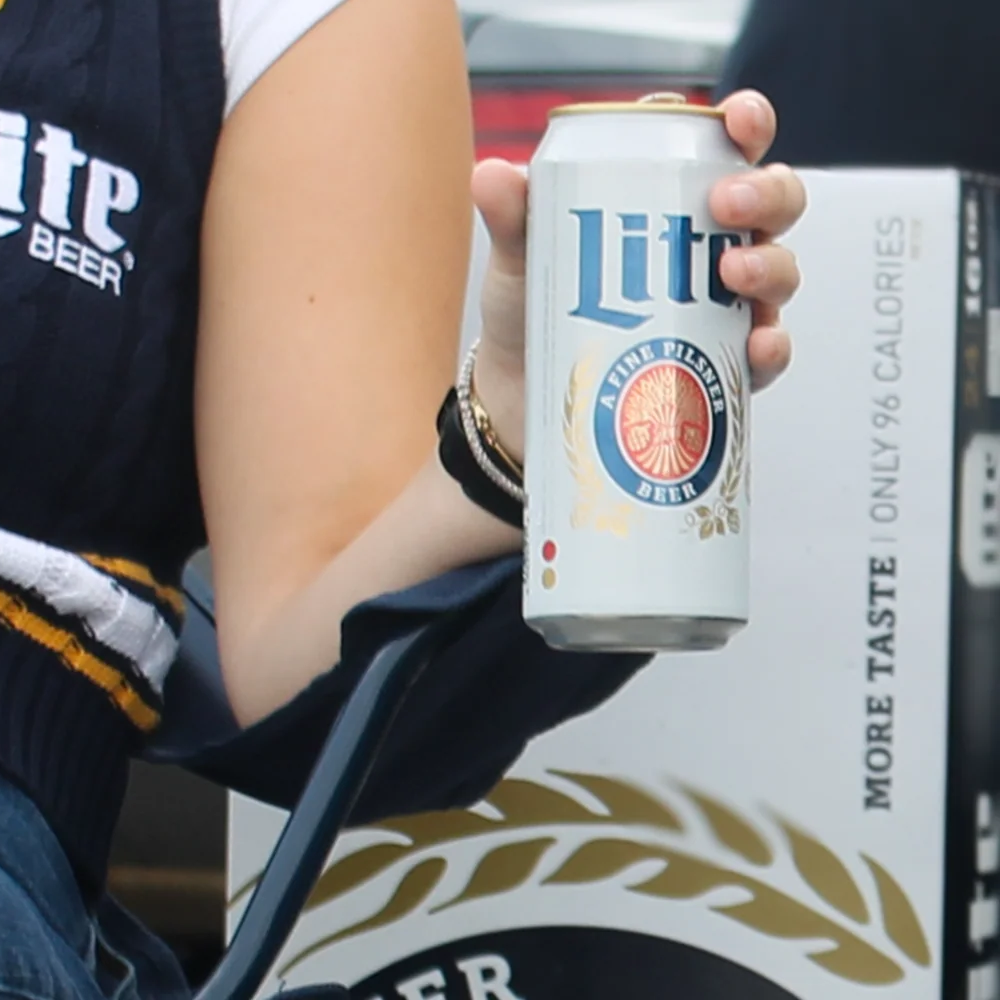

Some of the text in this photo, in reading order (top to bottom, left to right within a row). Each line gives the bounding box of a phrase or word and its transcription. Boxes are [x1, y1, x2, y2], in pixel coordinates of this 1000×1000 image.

[28, 222, 122, 297] BEER
[600, 340, 725, 415] A FINE PILSNER
[636, 481, 698, 502] BEER
[863, 215, 906, 812] MORE TASTE ONLY 96 CALORIES
